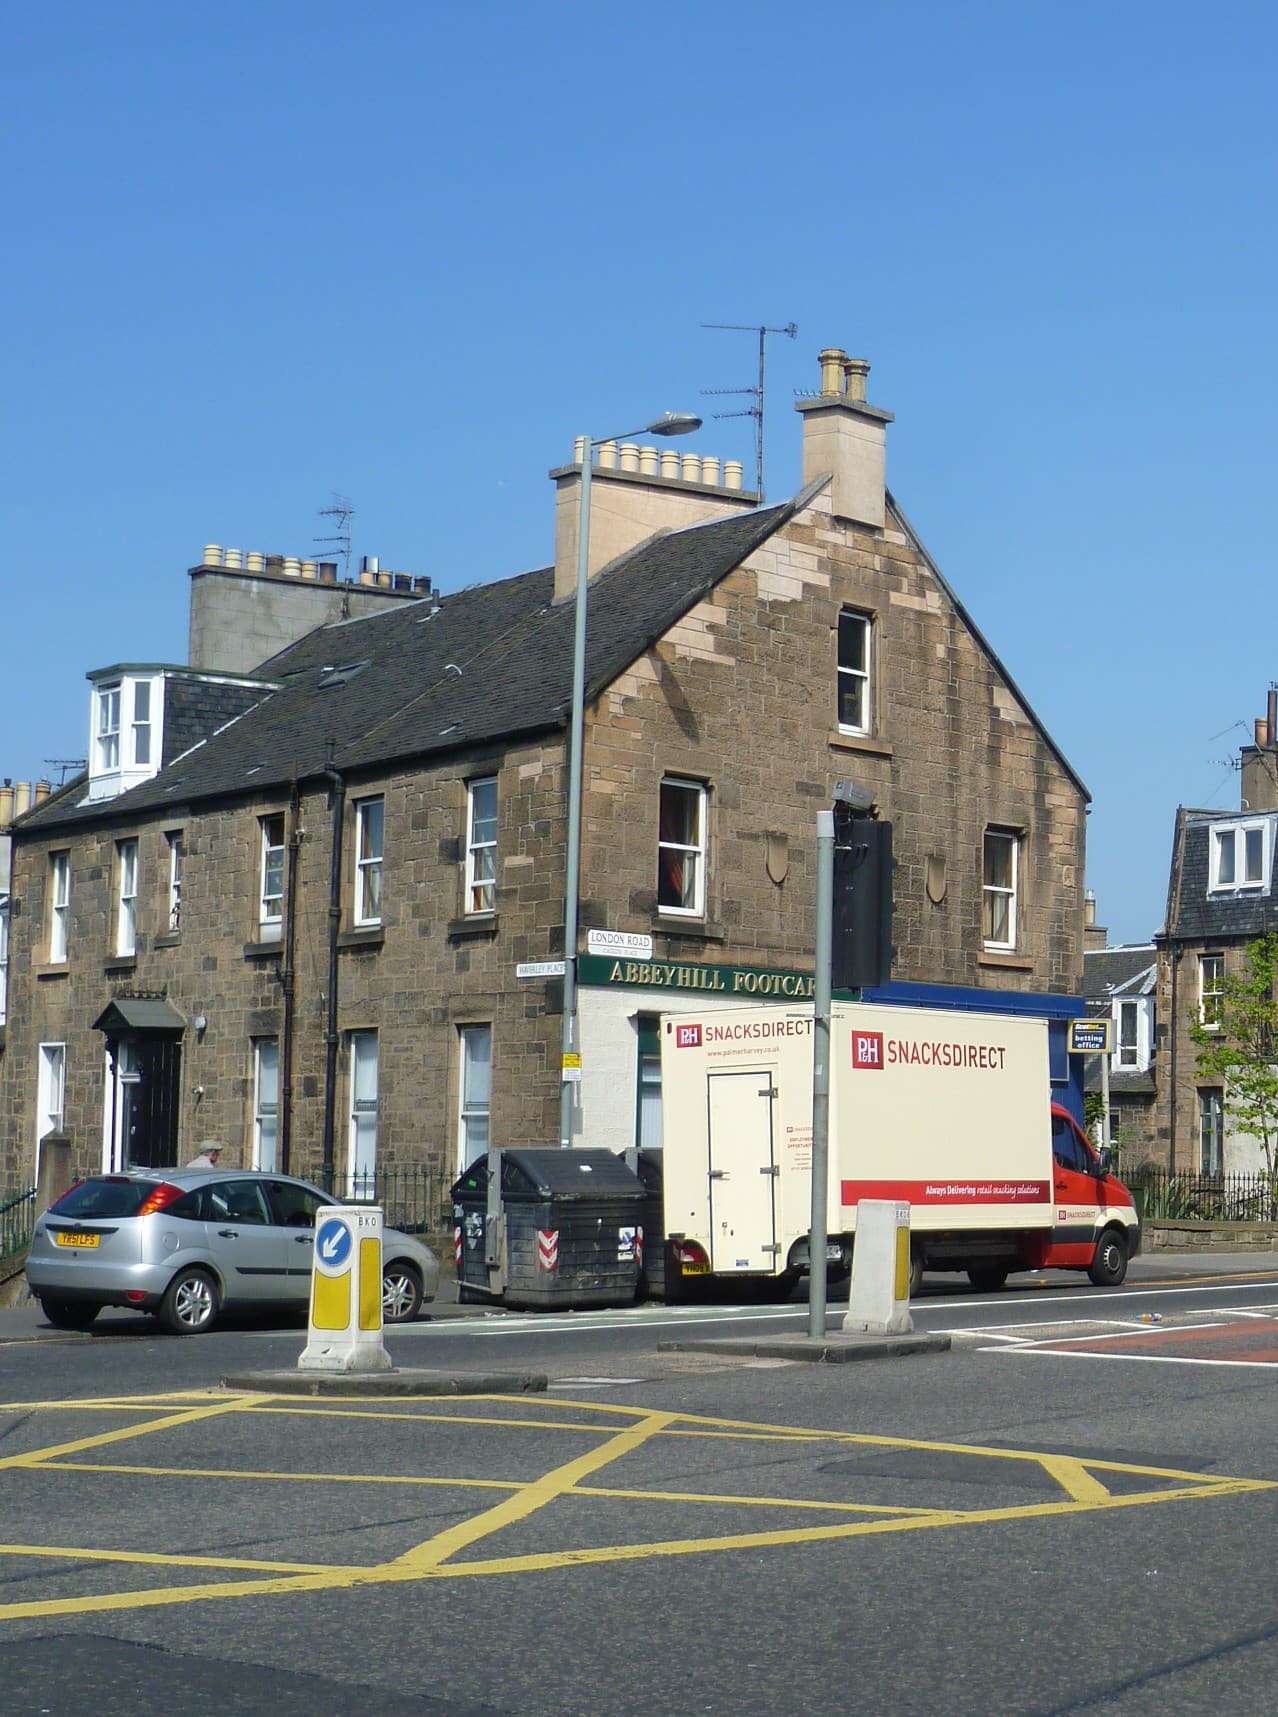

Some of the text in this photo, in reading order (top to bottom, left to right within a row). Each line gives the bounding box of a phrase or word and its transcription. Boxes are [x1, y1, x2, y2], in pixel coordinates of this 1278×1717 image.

[591, 931, 650, 947] LONDON ROAD
[609, 961, 816, 997] ABBEYHILL FOOTCAR
[705, 1019, 813, 1042] SNACKSDIRECT
[1075, 1033, 1104, 1043] betting
[887, 1040, 1006, 1070] SNACKSDIRECT
[925, 1185, 947, 1196] Always
[947, 1185, 976, 1196] Delivering
